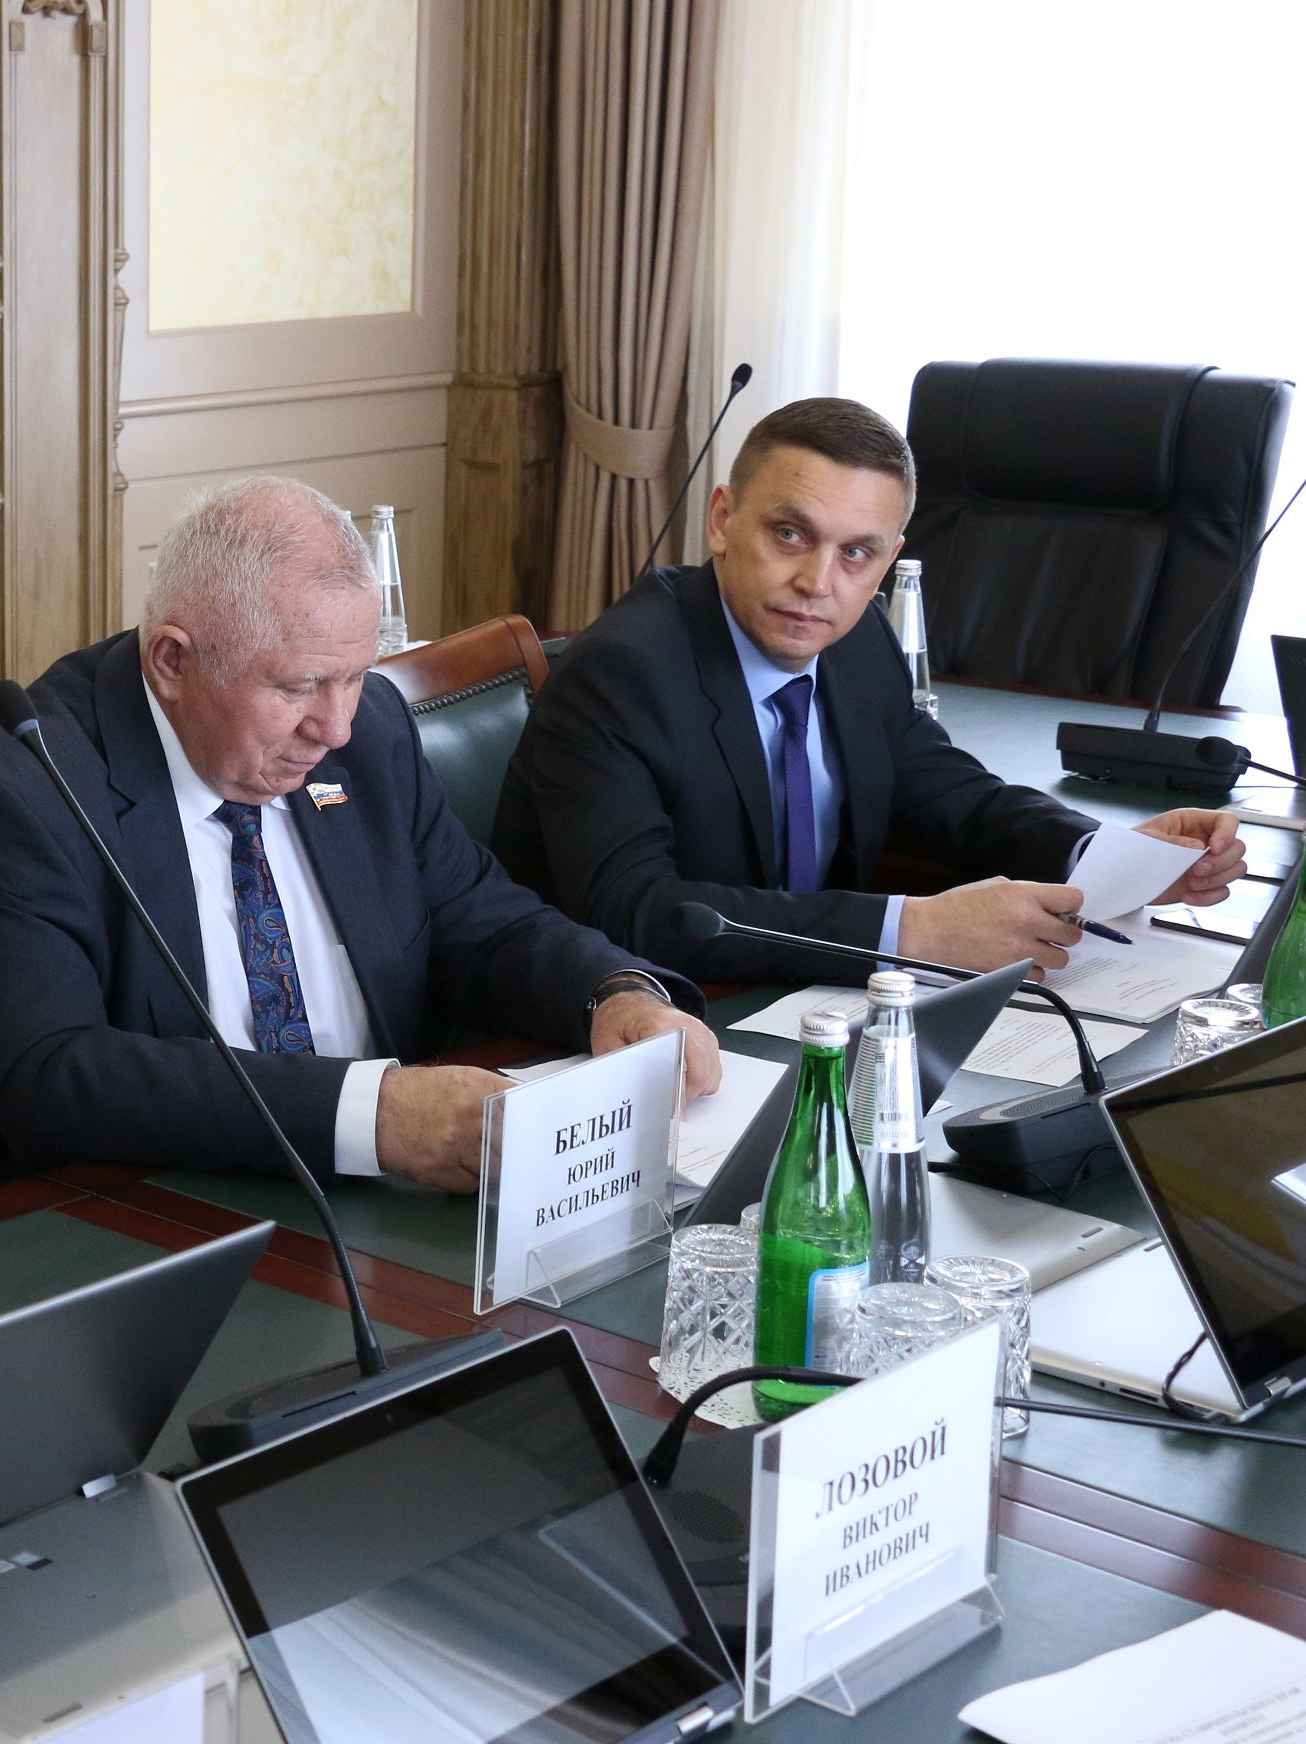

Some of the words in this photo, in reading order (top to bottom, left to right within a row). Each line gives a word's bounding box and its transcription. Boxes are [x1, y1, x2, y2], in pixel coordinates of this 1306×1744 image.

[554, 1098, 633, 1156] БЕЛЫЙ
[566, 1146, 616, 1186] ЮРИЙ
[535, 1169, 641, 1228] ВАСИЛЬЕВИЧ
[815, 1417, 947, 1519] ЛОЗОВОЙ
[842, 1492, 919, 1550] ВИКТОР
[825, 1522, 930, 1597] ИВАНОВИЧ
